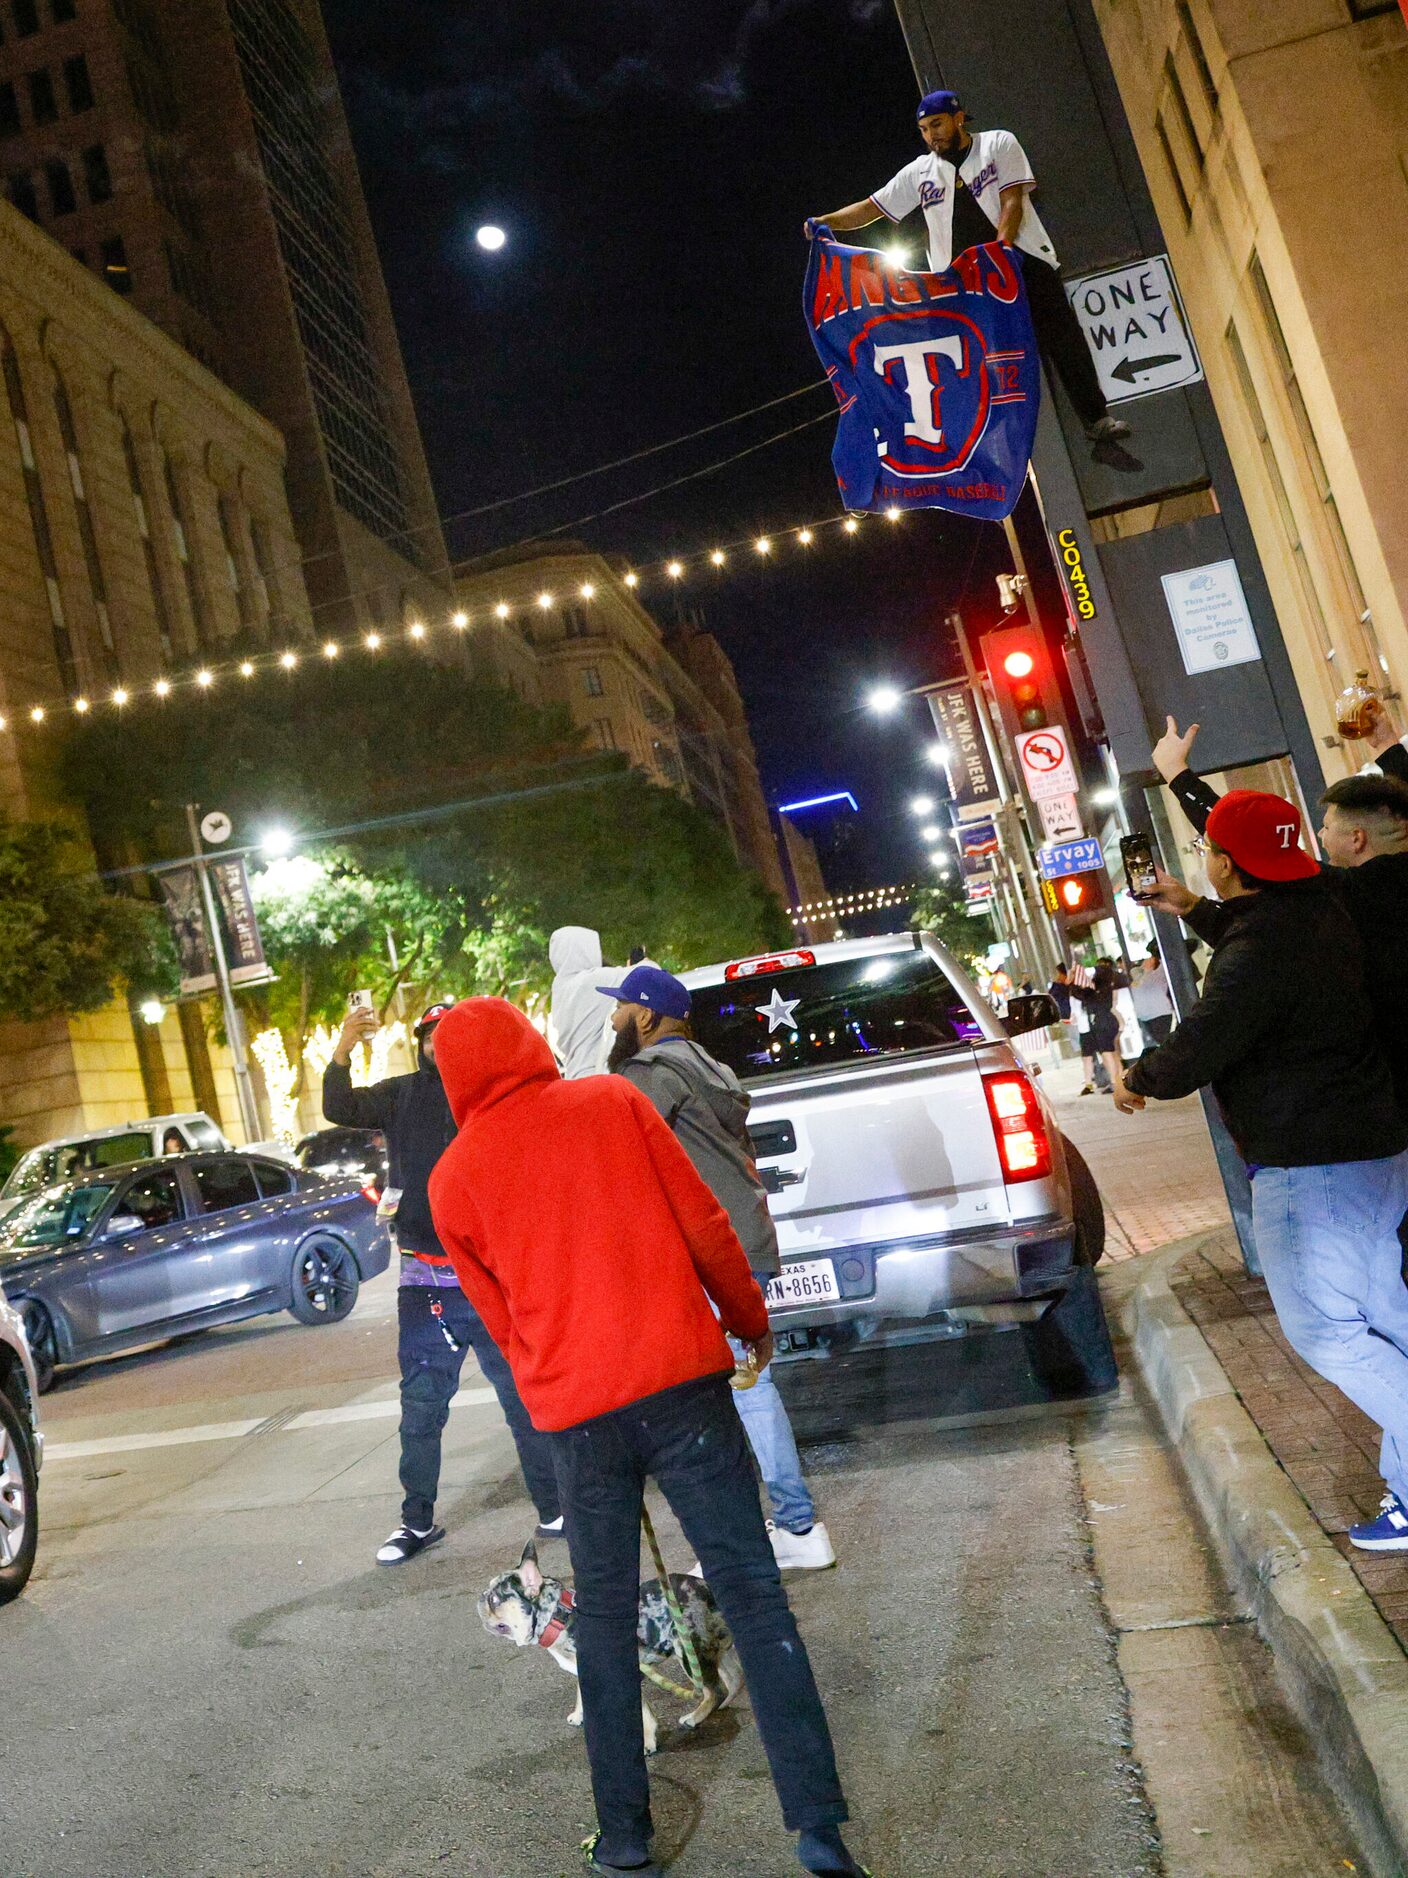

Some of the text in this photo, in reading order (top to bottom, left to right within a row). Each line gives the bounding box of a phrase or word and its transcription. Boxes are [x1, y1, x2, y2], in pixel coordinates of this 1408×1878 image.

[1084, 271, 1162, 316] ONE
[1089, 305, 1170, 351] WAY
[995, 365, 1020, 390] 72
[873, 335, 971, 453] T
[1184, 592, 1227, 606] This area
[1186, 599, 1233, 616] monitored
[1206, 614, 1217, 622] by
[1215, 617, 1244, 628] Police
[1197, 628, 1238, 642] Cameras
[947, 693, 968, 718] JFK
[955, 719, 978, 753] WAS
[966, 755, 989, 795] HERE
[1044, 800, 1068, 813] ONE
[1046, 809, 1074, 825] WAY
[1275, 823, 1295, 849] T
[1041, 843, 1095, 865] Ervay
[1046, 867, 1057, 877] St
[230, 888, 249, 920] WAS
[236, 922, 256, 960] HERE
[779, 1265, 806, 1276] EXAS
